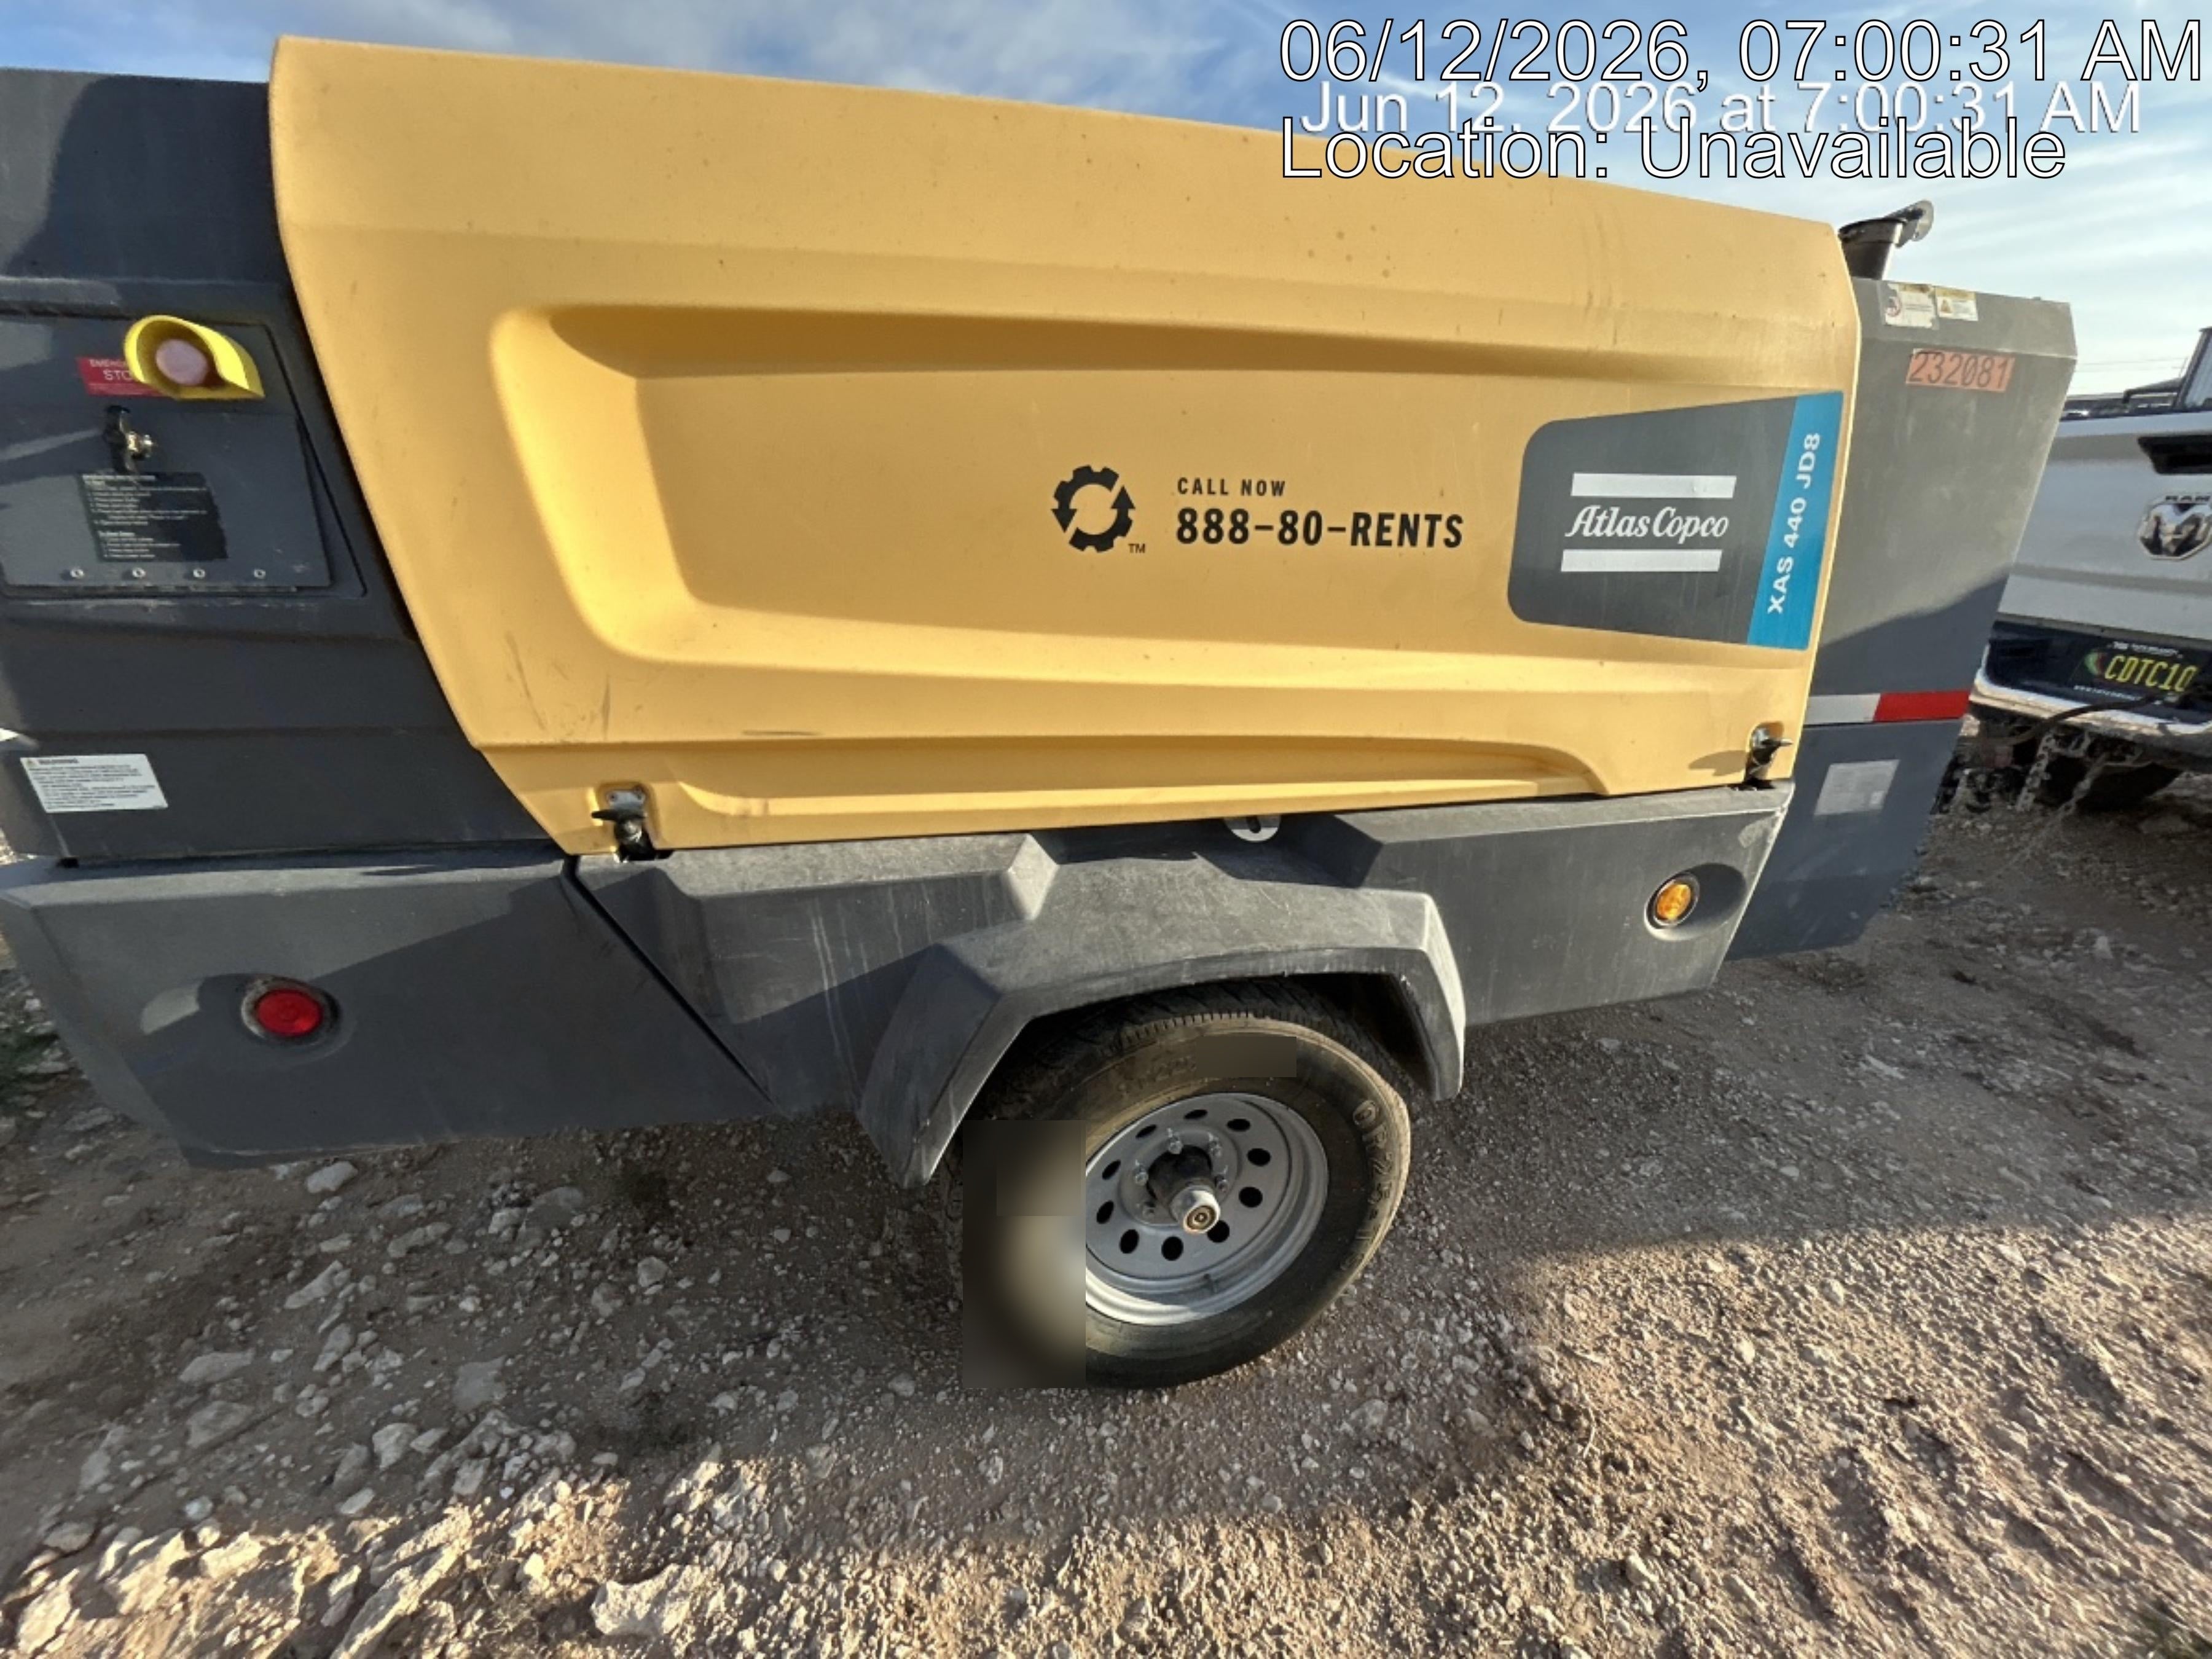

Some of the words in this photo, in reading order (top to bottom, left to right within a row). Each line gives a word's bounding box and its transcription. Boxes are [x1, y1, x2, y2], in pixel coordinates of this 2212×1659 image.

[103, 368, 133, 382] STO
[1908, 351, 2010, 390] 232081
[1177, 477, 1230, 495] CALL
[1241, 479, 1287, 497] NOW
[1176, 507, 1464, 549] 888-80-RENTS
[1564, 504, 1650, 538] Atlas
[1652, 506, 1730, 544] Copco
[1767, 555, 1795, 614] XAS
[1783, 496, 1806, 548] 440
[1795, 432, 1821, 489] JD8
[1128, 543, 1146, 553] TM
[2104, 655, 2198, 692] CDTC10
